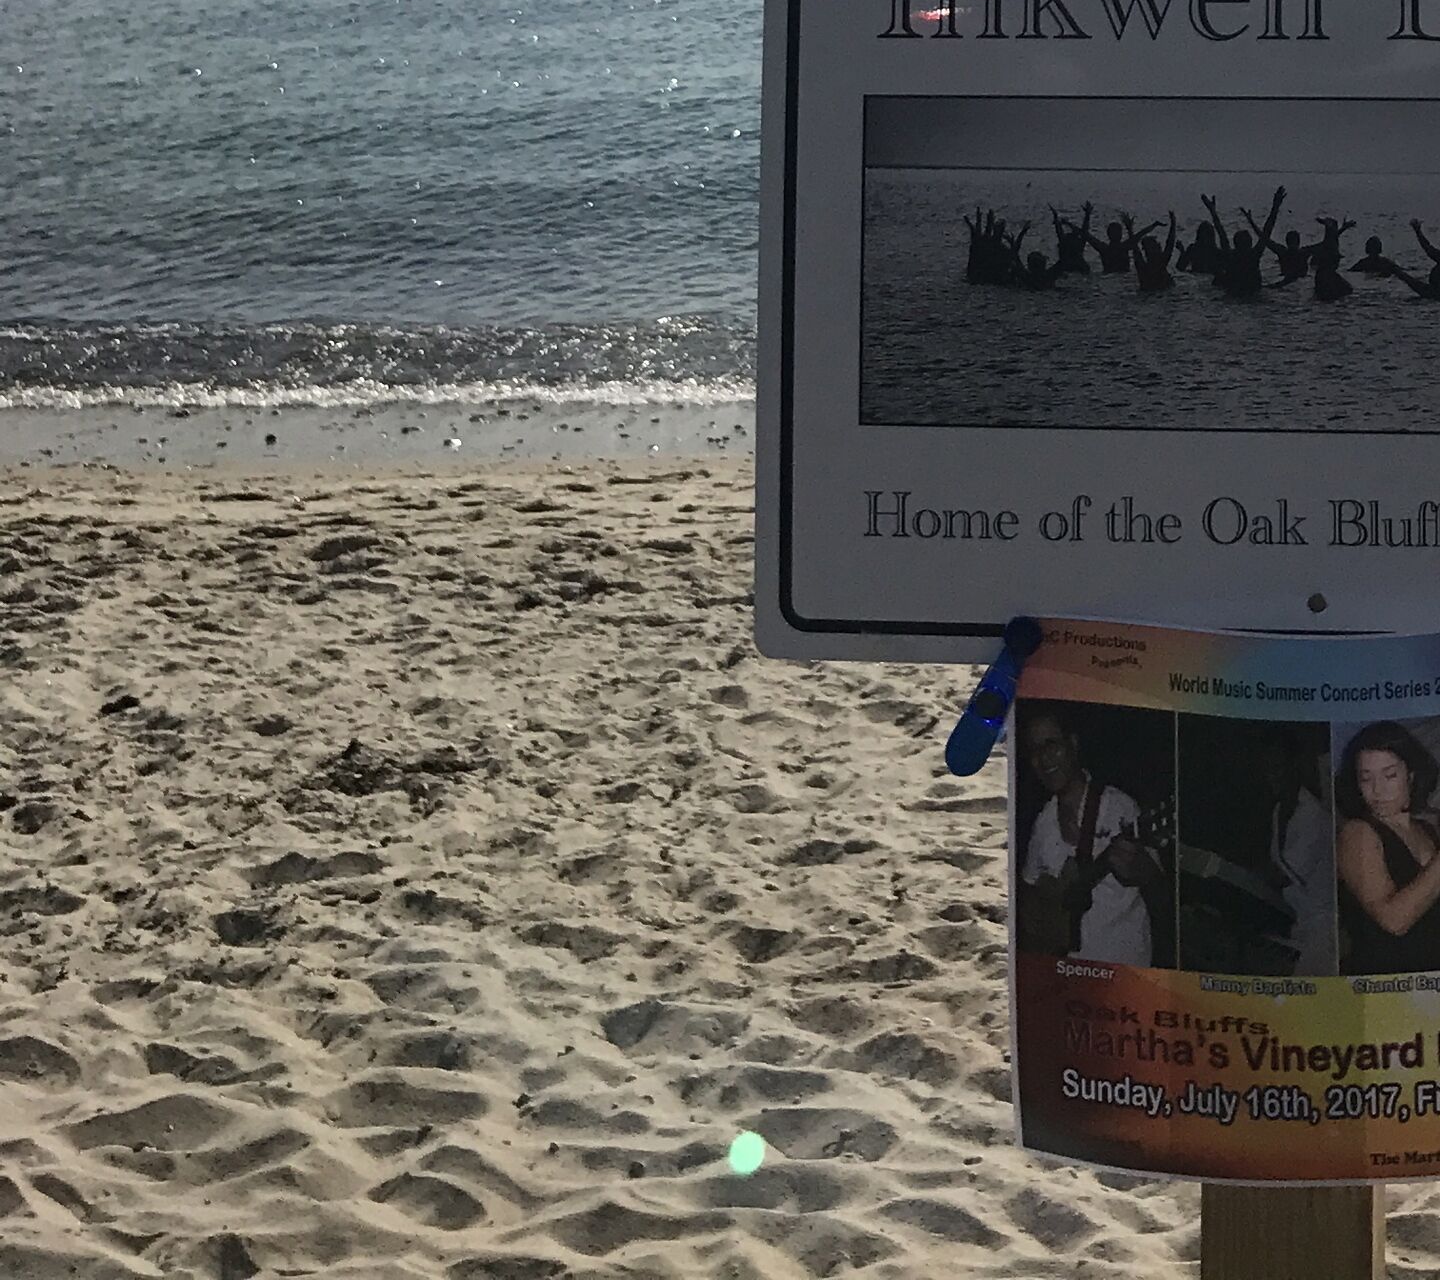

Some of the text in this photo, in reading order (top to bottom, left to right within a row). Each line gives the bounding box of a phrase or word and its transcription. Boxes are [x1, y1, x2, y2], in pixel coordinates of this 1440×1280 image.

[863, 491, 1020, 541] Home
[1038, 495, 1093, 542] of
[1105, 496, 1182, 544] the
[1201, 497, 1309, 546] Oak
[1168, 673, 1209, 694] World
[1212, 678, 1252, 698] Music
[1255, 681, 1317, 702] Summer
[1320, 683, 1381, 702] Concert
[1384, 680, 1431, 700] Series
[1056, 960, 1115, 980] Spencer
[1241, 1030, 1425, 1080] Vineyard
[1060, 1066, 1173, 1117] Sunday,
[1178, 1081, 1239, 1125] July
[1243, 1085, 1320, 1126] 16th,
[1325, 1082, 1411, 1124] 2017,
